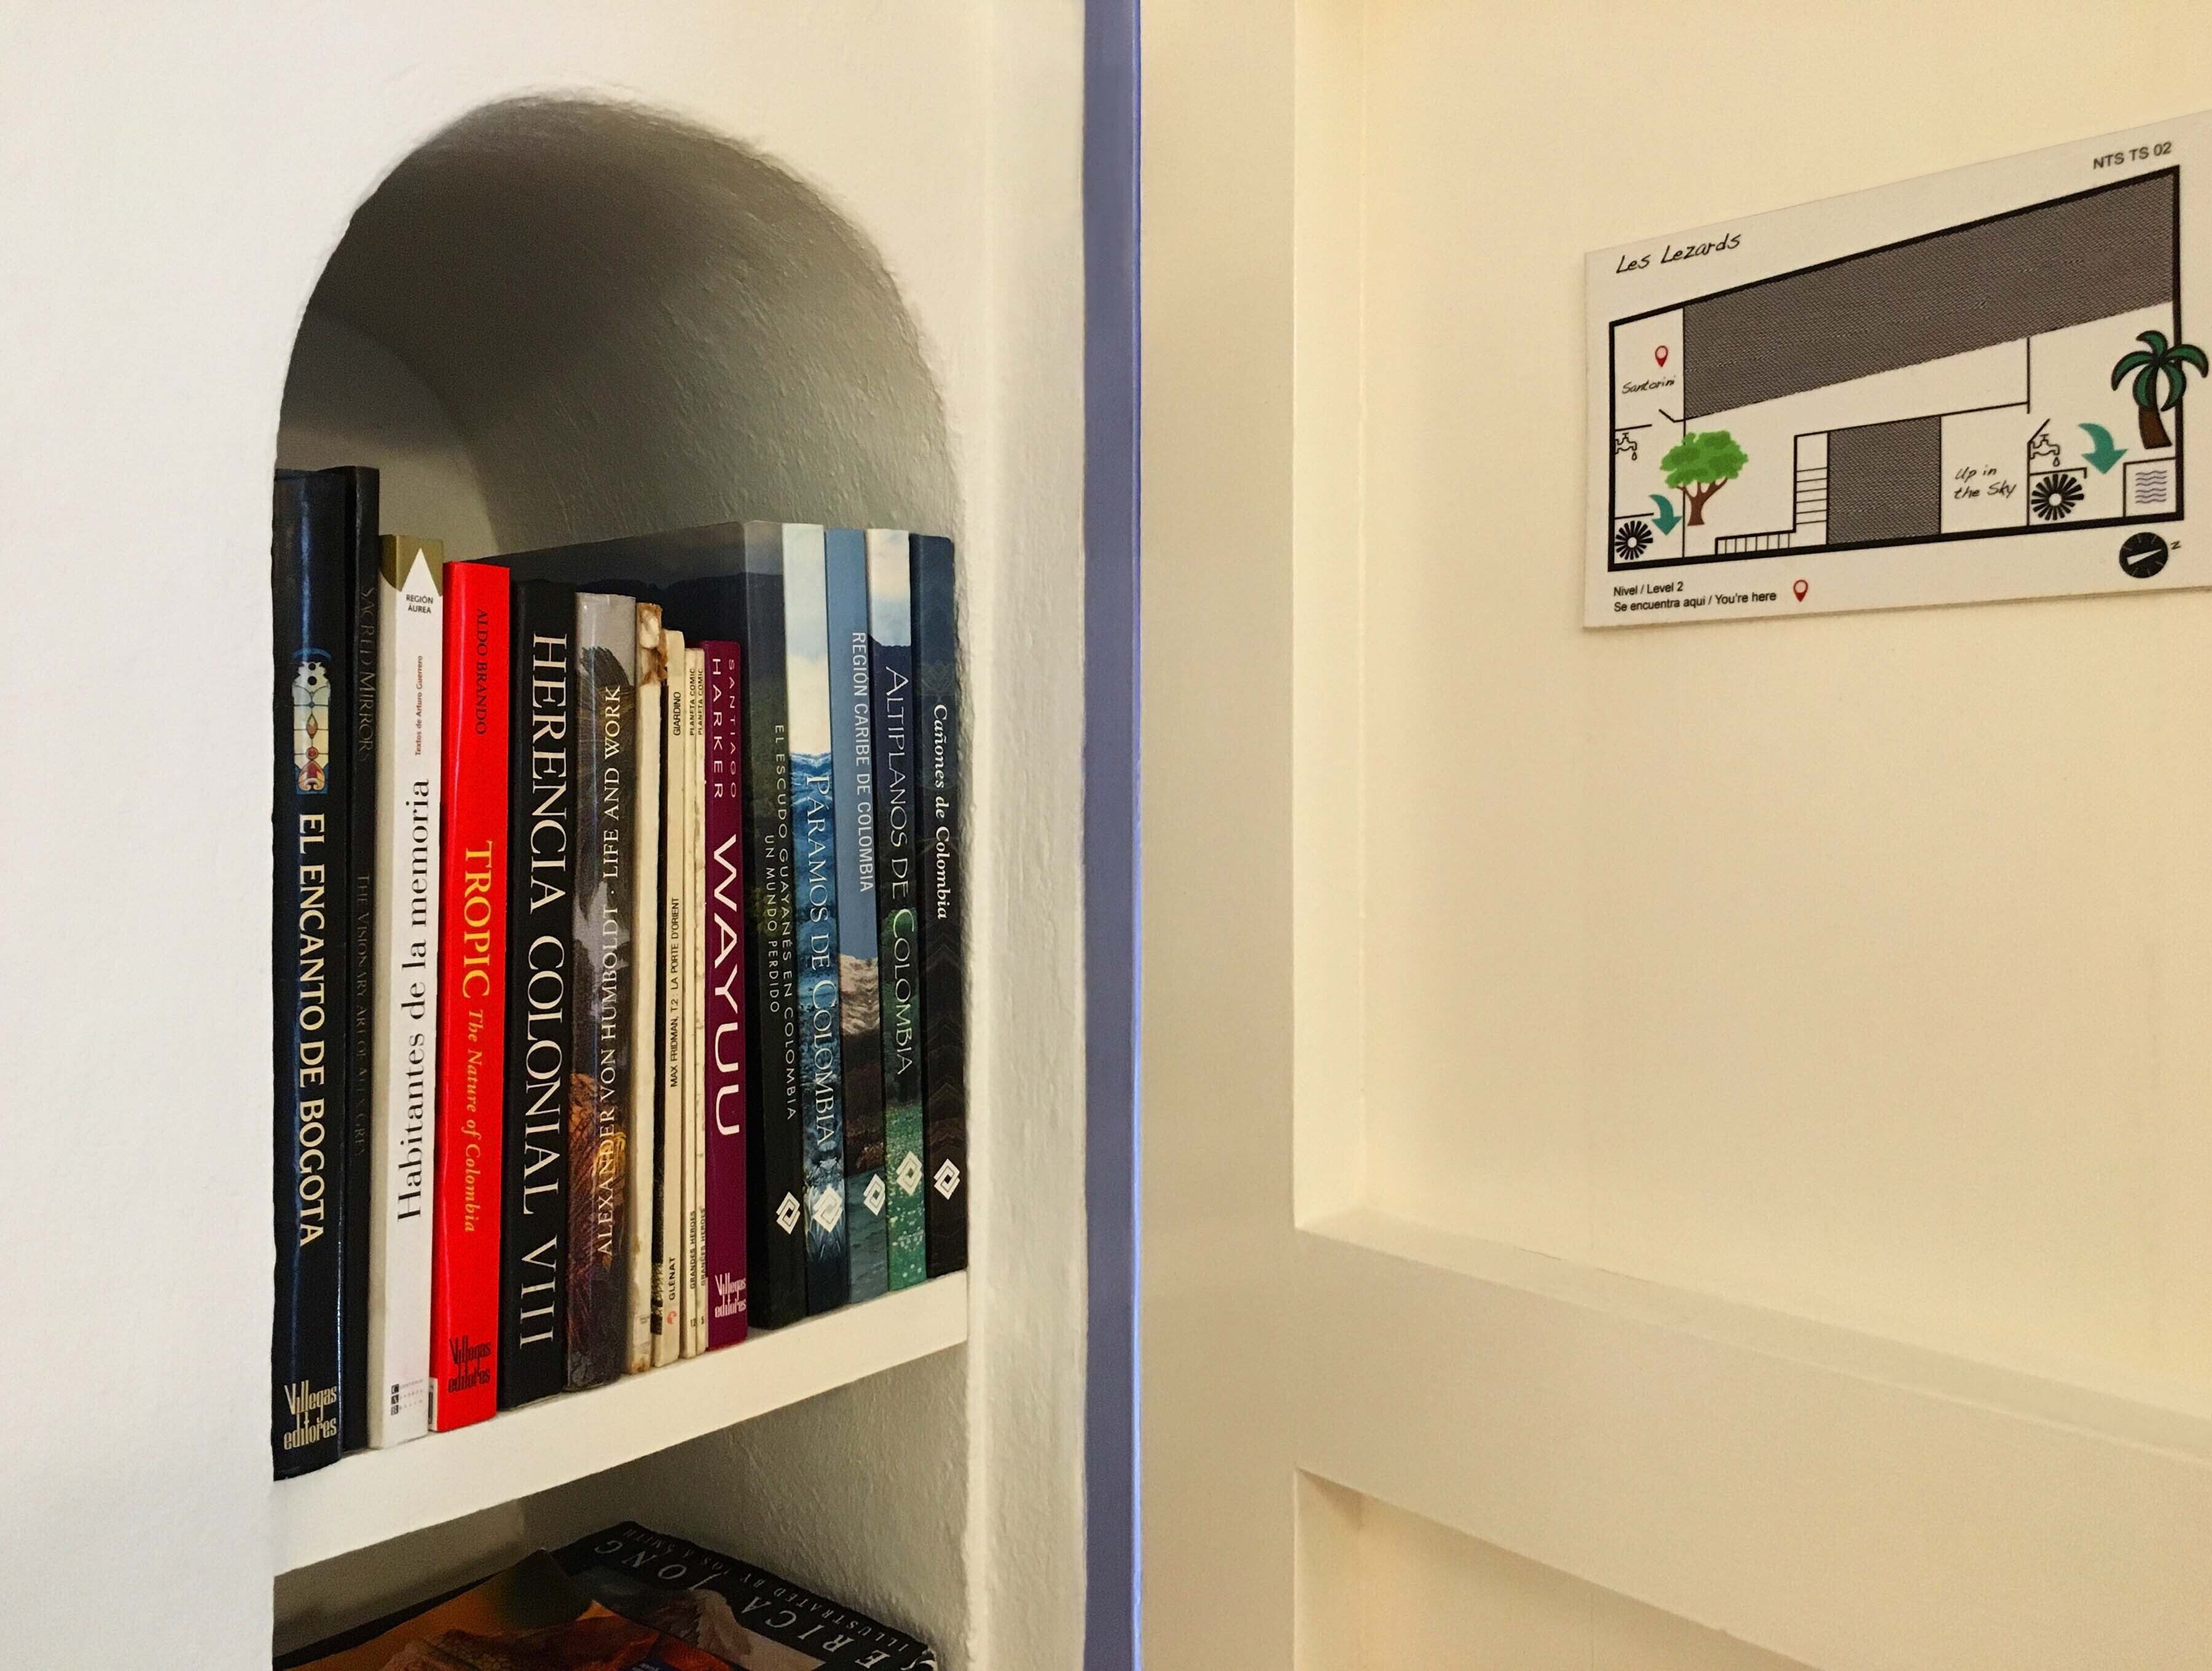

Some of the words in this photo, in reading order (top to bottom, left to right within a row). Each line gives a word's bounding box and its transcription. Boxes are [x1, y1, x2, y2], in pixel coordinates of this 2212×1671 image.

[2093, 152, 2125, 170] NTS
[2128, 146, 2149, 161] TS
[2154, 141, 2172, 156] 02
[1616, 254, 1651, 273] Les
[1661, 233, 1741, 264] Lezards
[1622, 375, 1677, 394] Santorini
[1954, 486, 1980, 499] the
[1955, 467, 1977, 483] Up
[1983, 464, 1997, 475] in
[406, 594, 433, 604] REGIÓN
[407, 604, 431, 614] ÁUREA
[1614, 585, 1637, 596] Nivel
[1647, 583, 1674, 594] Level
[1677, 581, 1684, 592] 2
[1614, 601, 1627, 612] Se
[1630, 598, 1680, 611] encuentra
[1715, 593, 1748, 605] You're
[1752, 592, 1776, 602] here
[476, 608, 488, 656] ALDO
[852, 632, 868, 697] REGIÓN
[476, 661, 487, 735] BRANDO
[604, 685, 621, 759] WORK
[416, 719, 422, 729] de
[712, 658, 724, 798] HARKER
[775, 725, 785, 744] EL
[854, 705, 870, 766] CARIBE
[933, 703, 948, 789] Cañones
[530, 633, 568, 914] HERENCIA
[885, 666, 909, 848] ALTIPLANOS
[603, 767, 620, 821] AND
[776, 754, 788, 838] ESCUDO
[856, 773, 871, 796] DE
[935, 796, 949, 819] de
[299, 813, 324, 854] EL
[406, 778, 429, 926] memoria
[603, 829, 619, 879] LIFE
[764, 836, 774, 858] UN
[806, 775, 830, 923] PÁRAMOS
[857, 802, 874, 893] COLOMBIA
[891, 859, 909, 899] DE
[936, 824, 951, 920] Colombia
[462, 840, 493, 998] TROPIC
[766, 867, 777, 931] MUNDO
[779, 848, 793, 961] GUAYANÉS
[299, 864, 325, 1031] ENCANTO
[402, 939, 426, 969] la
[601, 905, 618, 1041] HUMBOLDT
[810, 934, 830, 971] DE
[401, 982, 426, 1020] de
[671, 977, 678, 990] LA
[713, 834, 740, 1135] WAYUU
[768, 941, 780, 1013] PERDIDO
[783, 971, 793, 998] EN
[893, 908, 916, 1075] COLOMBIA
[466, 1009, 484, 1042] The
[670, 1017, 679, 1062] FRIDMAN,
[299, 1041, 324, 1087] DE
[465, 1050, 483, 1113] Nature
[523, 936, 564, 1215] COLONIAL
[601, 1049, 616, 1101] VON
[784, 1007, 796, 1120] COLOMBIA
[812, 979, 837, 1145] COLOMBIA
[396, 1034, 425, 1222] Habitantes
[461, 1118, 482, 1141] of
[299, 1097, 325, 1246] BOGOTA
[462, 1143, 481, 1232] Colombia
[598, 1106, 616, 1256] ALEXANDER
[519, 1234, 558, 1350] VIII
[715, 1272, 746, 1301] Villegas
[715, 1295, 747, 1318] editores
[449, 1334, 490, 1372] Villegas
[284, 1380, 337, 1423] Villegas
[448, 1365, 490, 1393] editores
[283, 1412, 337, 1450] editores
[739, 1572, 765, 1589] BY
[741, 1597, 890, 1670] ERICA
[772, 1586, 910, 1653] ILLUSTRATED
